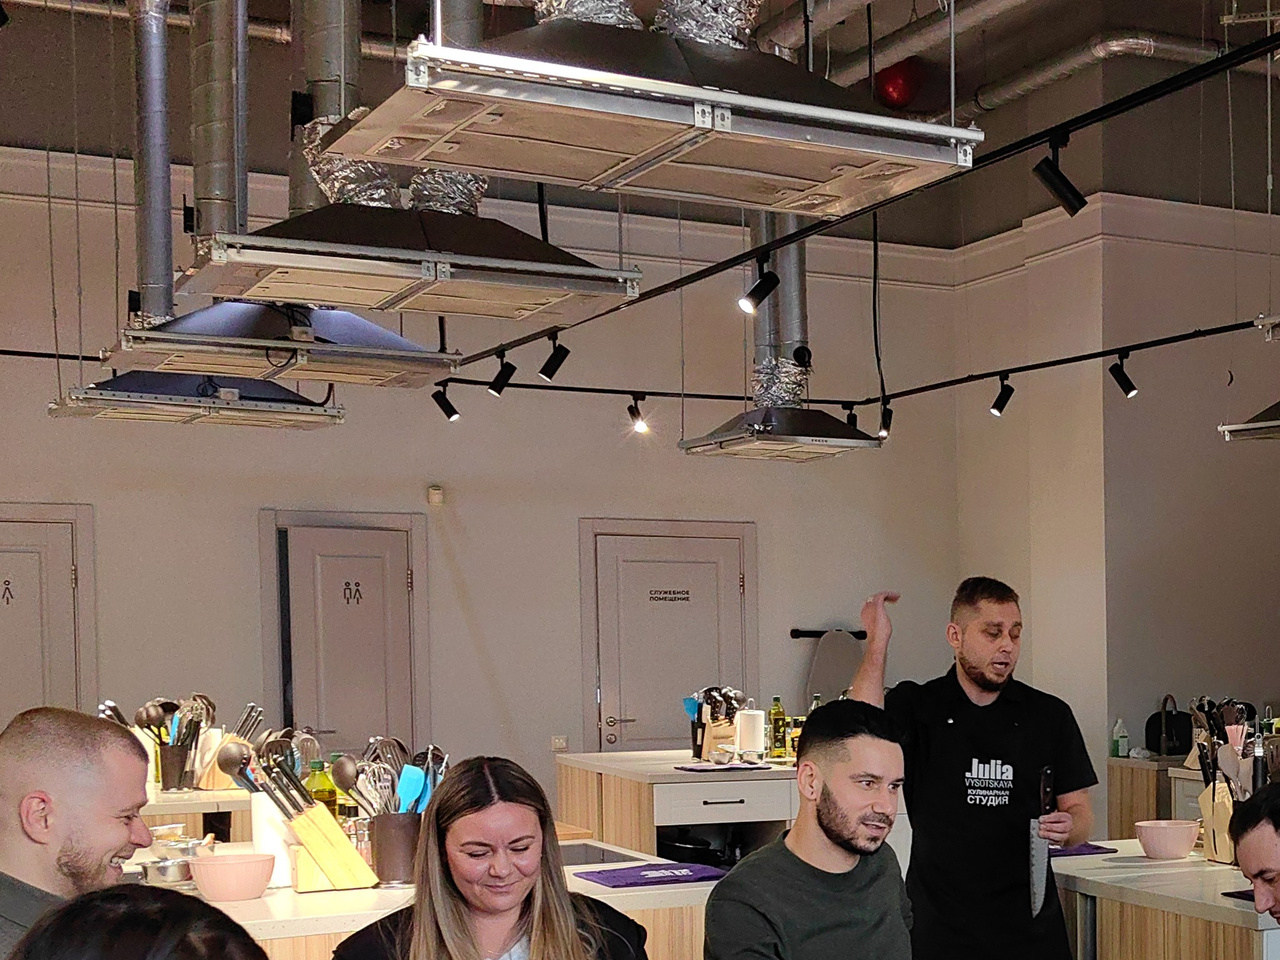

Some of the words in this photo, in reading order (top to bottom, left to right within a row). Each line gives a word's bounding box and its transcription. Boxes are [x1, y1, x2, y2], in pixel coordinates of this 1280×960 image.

[965, 758, 1013, 780] Julia
[965, 778, 1013, 788] VYSOTSKAYA
[967, 795, 1009, 806] СТУДИЯ
